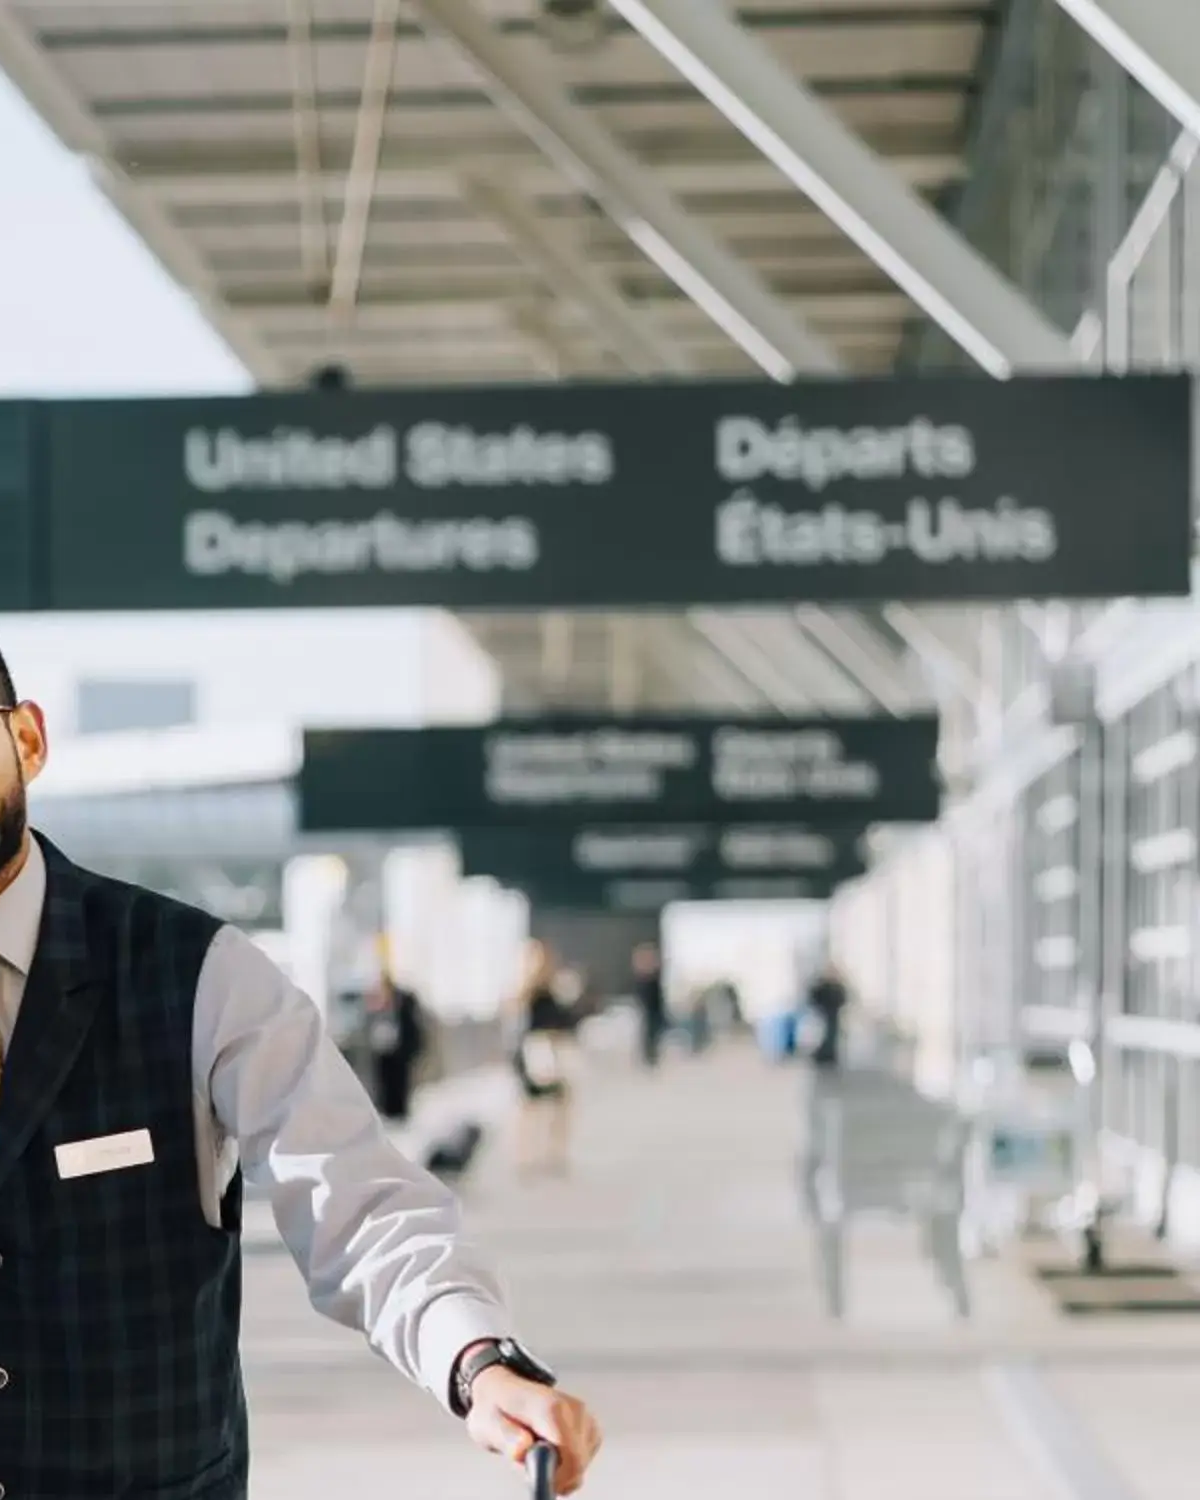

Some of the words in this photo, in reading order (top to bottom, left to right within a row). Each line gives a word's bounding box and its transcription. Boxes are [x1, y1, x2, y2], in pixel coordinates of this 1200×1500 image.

[186, 425, 396, 489] United
[407, 423, 611, 486] States
[717, 417, 974, 488] Départs
[185, 511, 536, 581] Departures
[717, 491, 1055, 563] États-Unis
